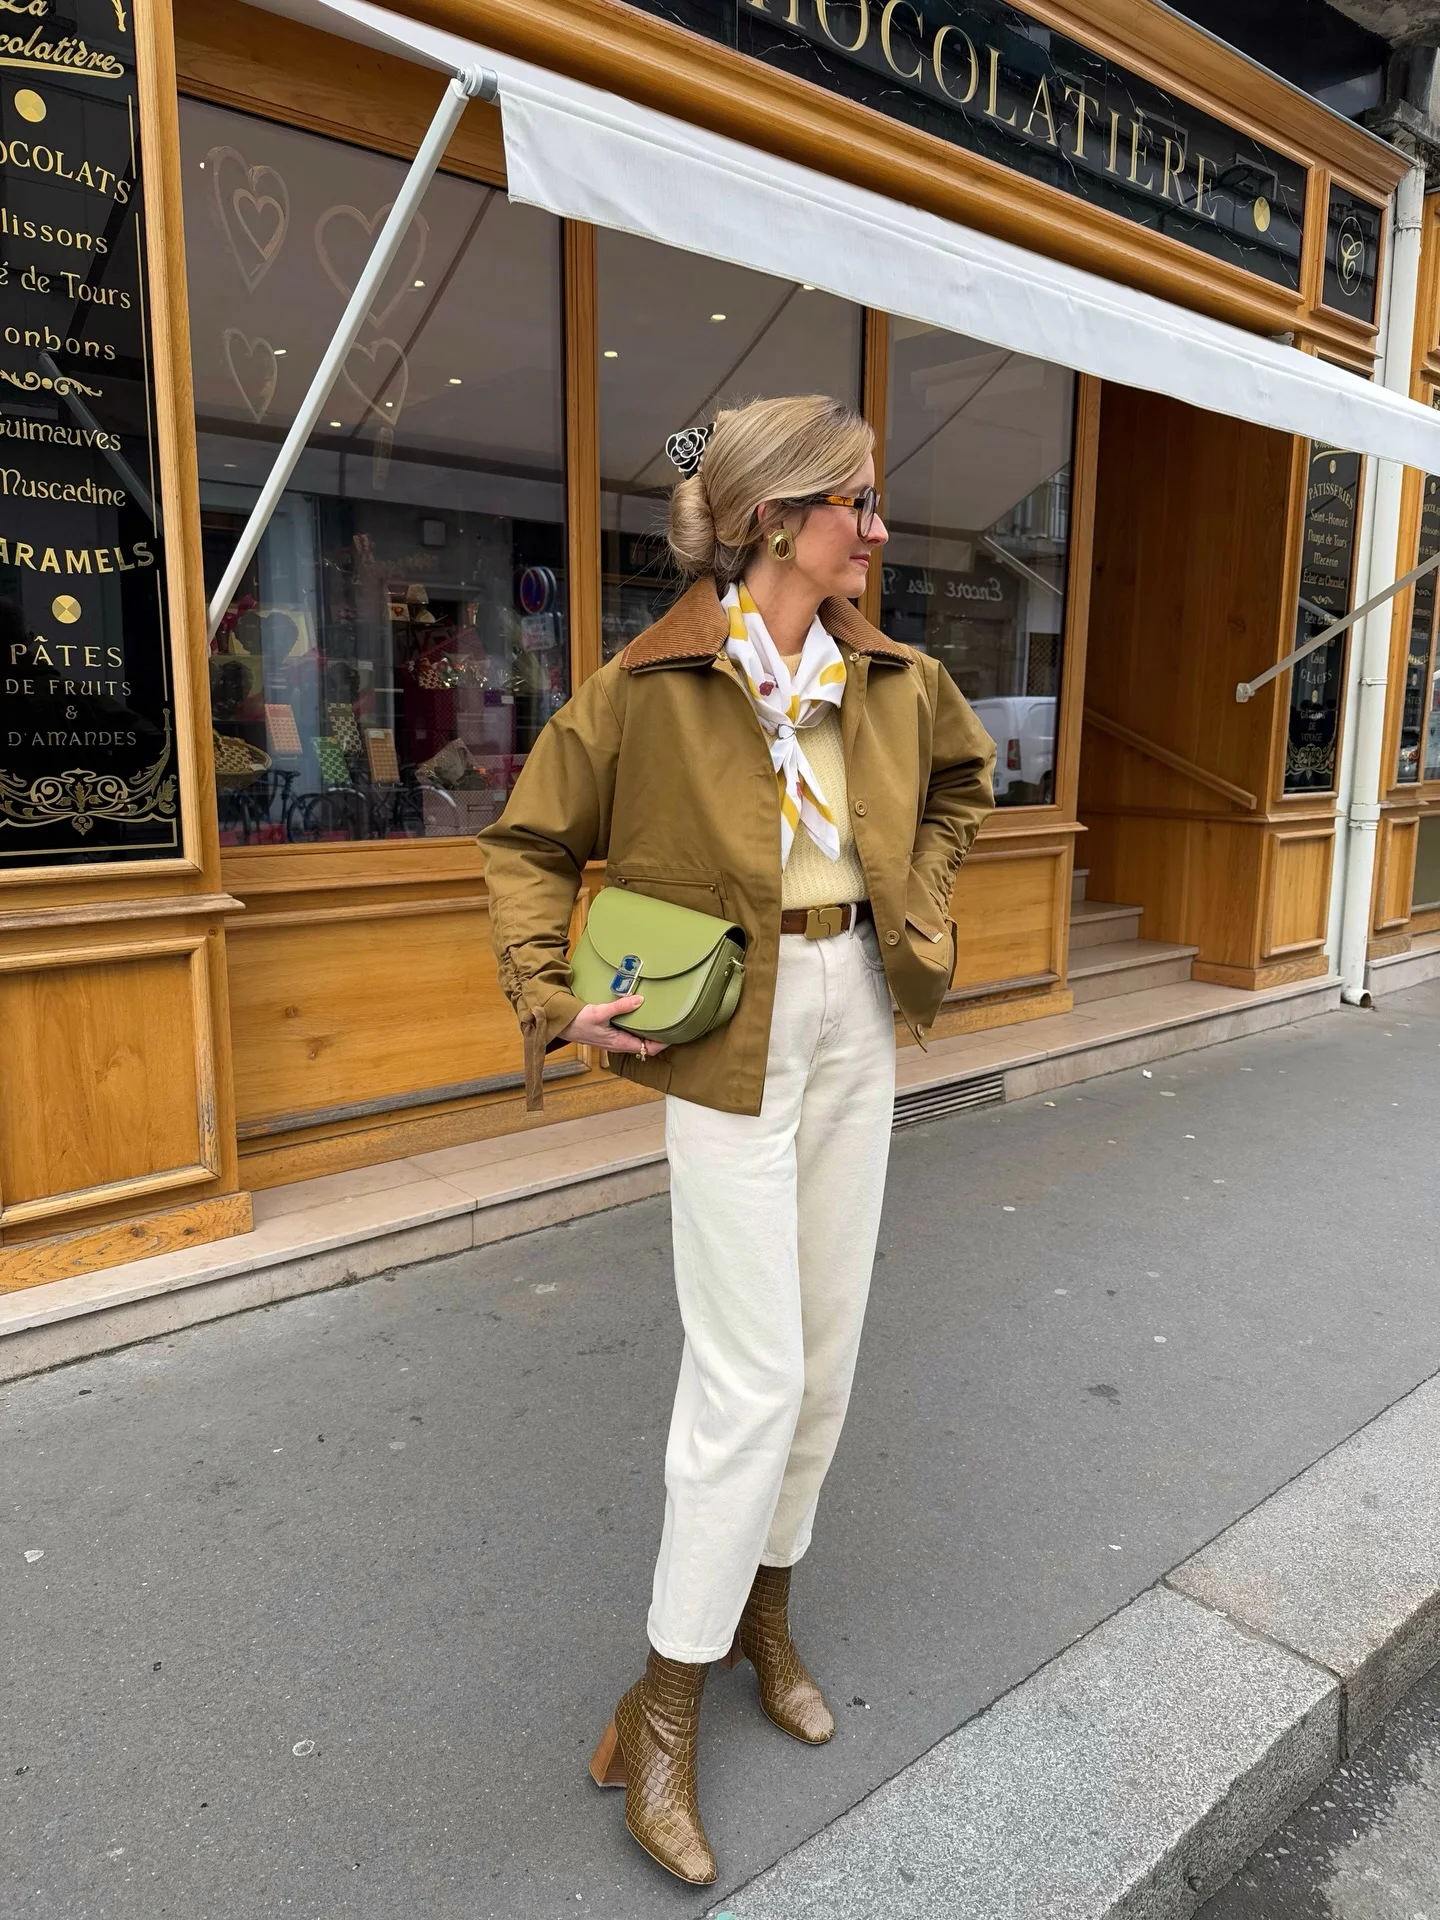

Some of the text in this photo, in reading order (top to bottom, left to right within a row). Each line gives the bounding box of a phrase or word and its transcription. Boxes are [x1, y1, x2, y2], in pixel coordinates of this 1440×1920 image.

[21, 265, 51, 294] de
[60, 271, 131, 309] Tours
[4, 326, 116, 361] onbons
[1308, 482, 1355, 510] PÂTISSERIES
[10, 635, 123, 668] PÂTES
[5, 678, 132, 697] DE FRUITS
[1300, 668, 1333, 685] GLACES
[65, 705, 79, 720] &
[8, 731, 137, 747] D'AMANDES
